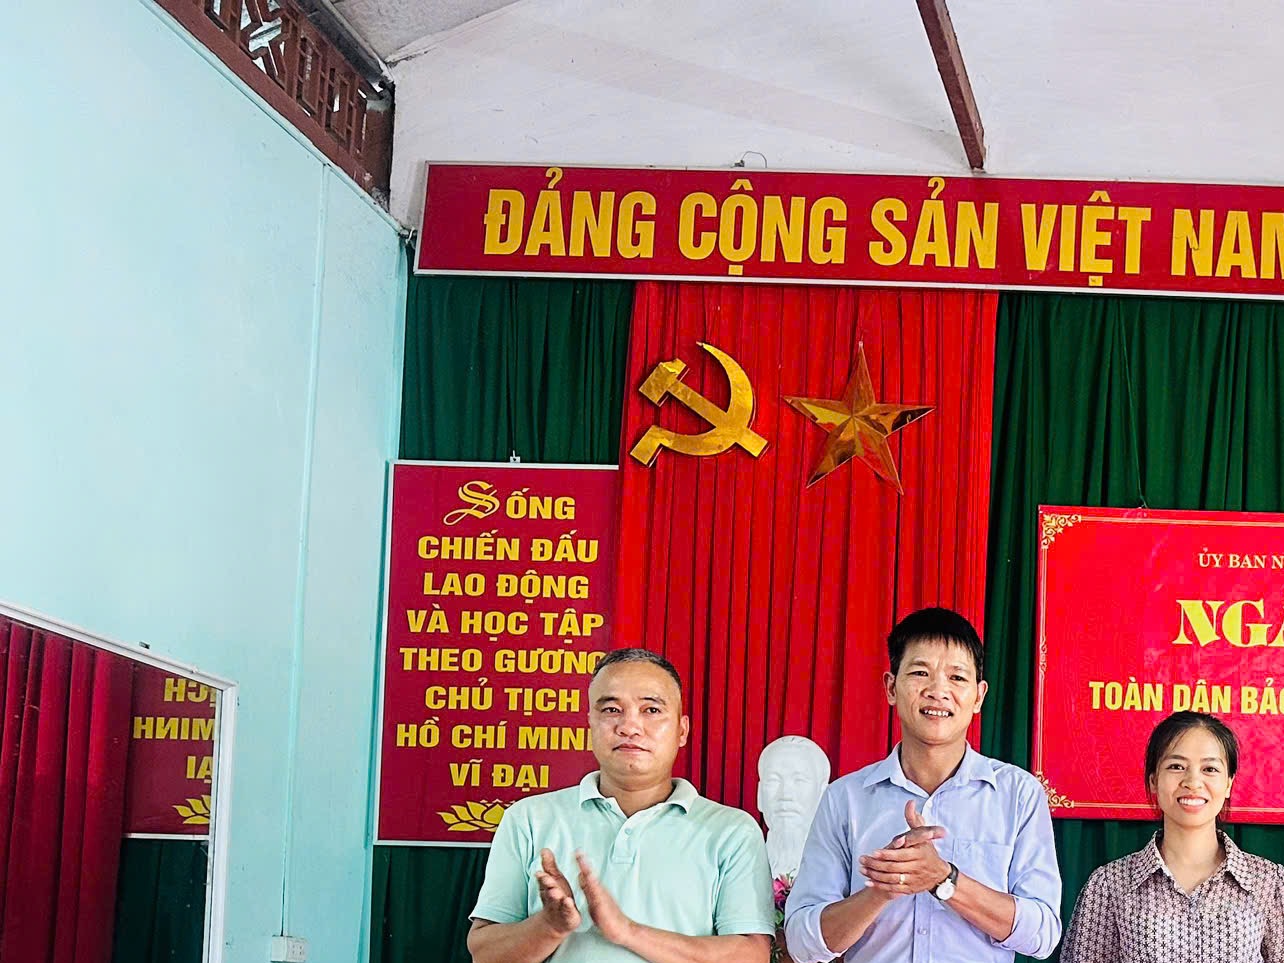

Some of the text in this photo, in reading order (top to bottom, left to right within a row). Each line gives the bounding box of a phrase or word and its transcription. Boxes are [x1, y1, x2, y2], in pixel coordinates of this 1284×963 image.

[483, 166, 657, 259] ĐẢNG
[678, 178, 848, 276] CỘNG
[868, 176, 1001, 270] SẢN
[1020, 189, 1151, 287] VIỆT
[443, 480, 576, 526] SỐNG
[418, 529, 599, 563] CHIẾN ĐẤU
[1199, 546, 1223, 568] ỦY
[1228, 554, 1267, 569] BAN
[423, 569, 589, 604] LAO ĐỘNG
[406, 603, 604, 644] VÀ HỌC TẬP
[400, 647, 483, 673] THEO
[425, 677, 580, 716] CHỦ TỊCH
[1089, 676, 1163, 712] TOÀN
[1173, 679, 1231, 713] DÂN
[396, 716, 593, 751] HỒ CHÍ MIN
[450, 759, 549, 793] VĨ ĐẠI
